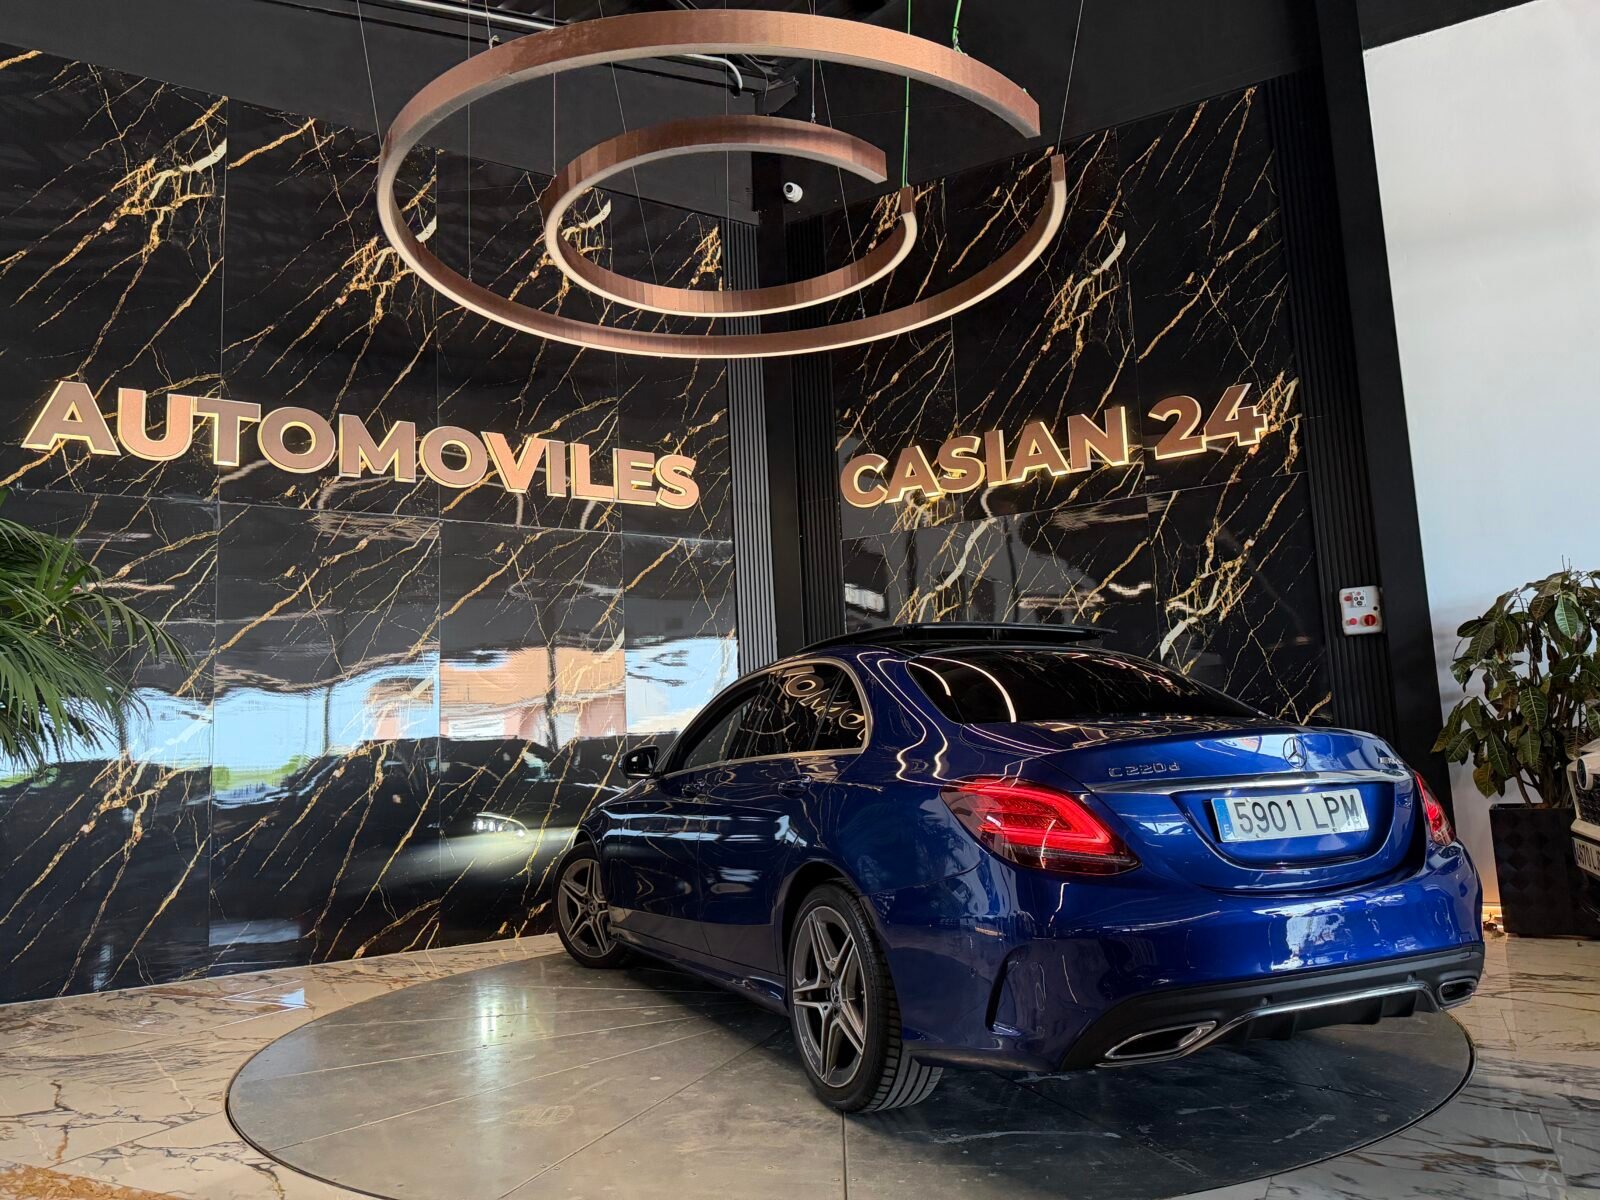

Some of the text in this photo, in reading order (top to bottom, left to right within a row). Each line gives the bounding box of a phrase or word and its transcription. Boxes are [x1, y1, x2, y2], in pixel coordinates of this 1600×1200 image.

[21, 380, 701, 510] AUTOMOVILES
[839, 382, 1268, 508] CASIAN 24
[1223, 794, 1361, 834] E 5901 LPM
